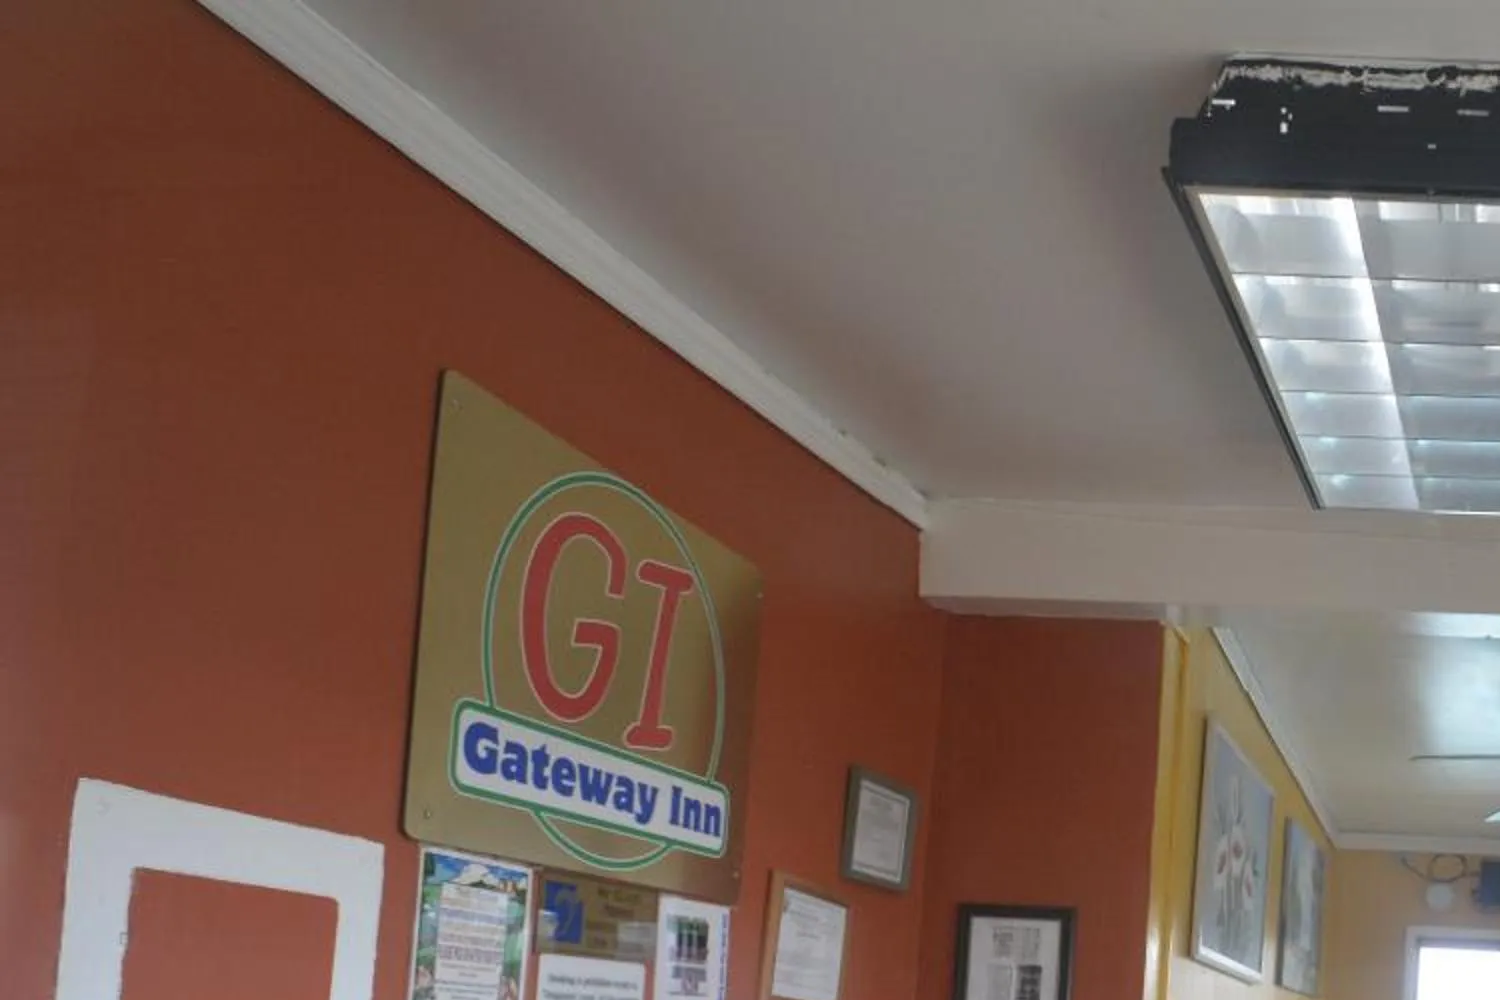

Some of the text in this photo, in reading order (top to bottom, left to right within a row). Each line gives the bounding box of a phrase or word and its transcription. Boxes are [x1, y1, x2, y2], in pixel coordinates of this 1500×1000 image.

[520, 511, 696, 751] GI
[463, 721, 721, 837] Gateway Inn
